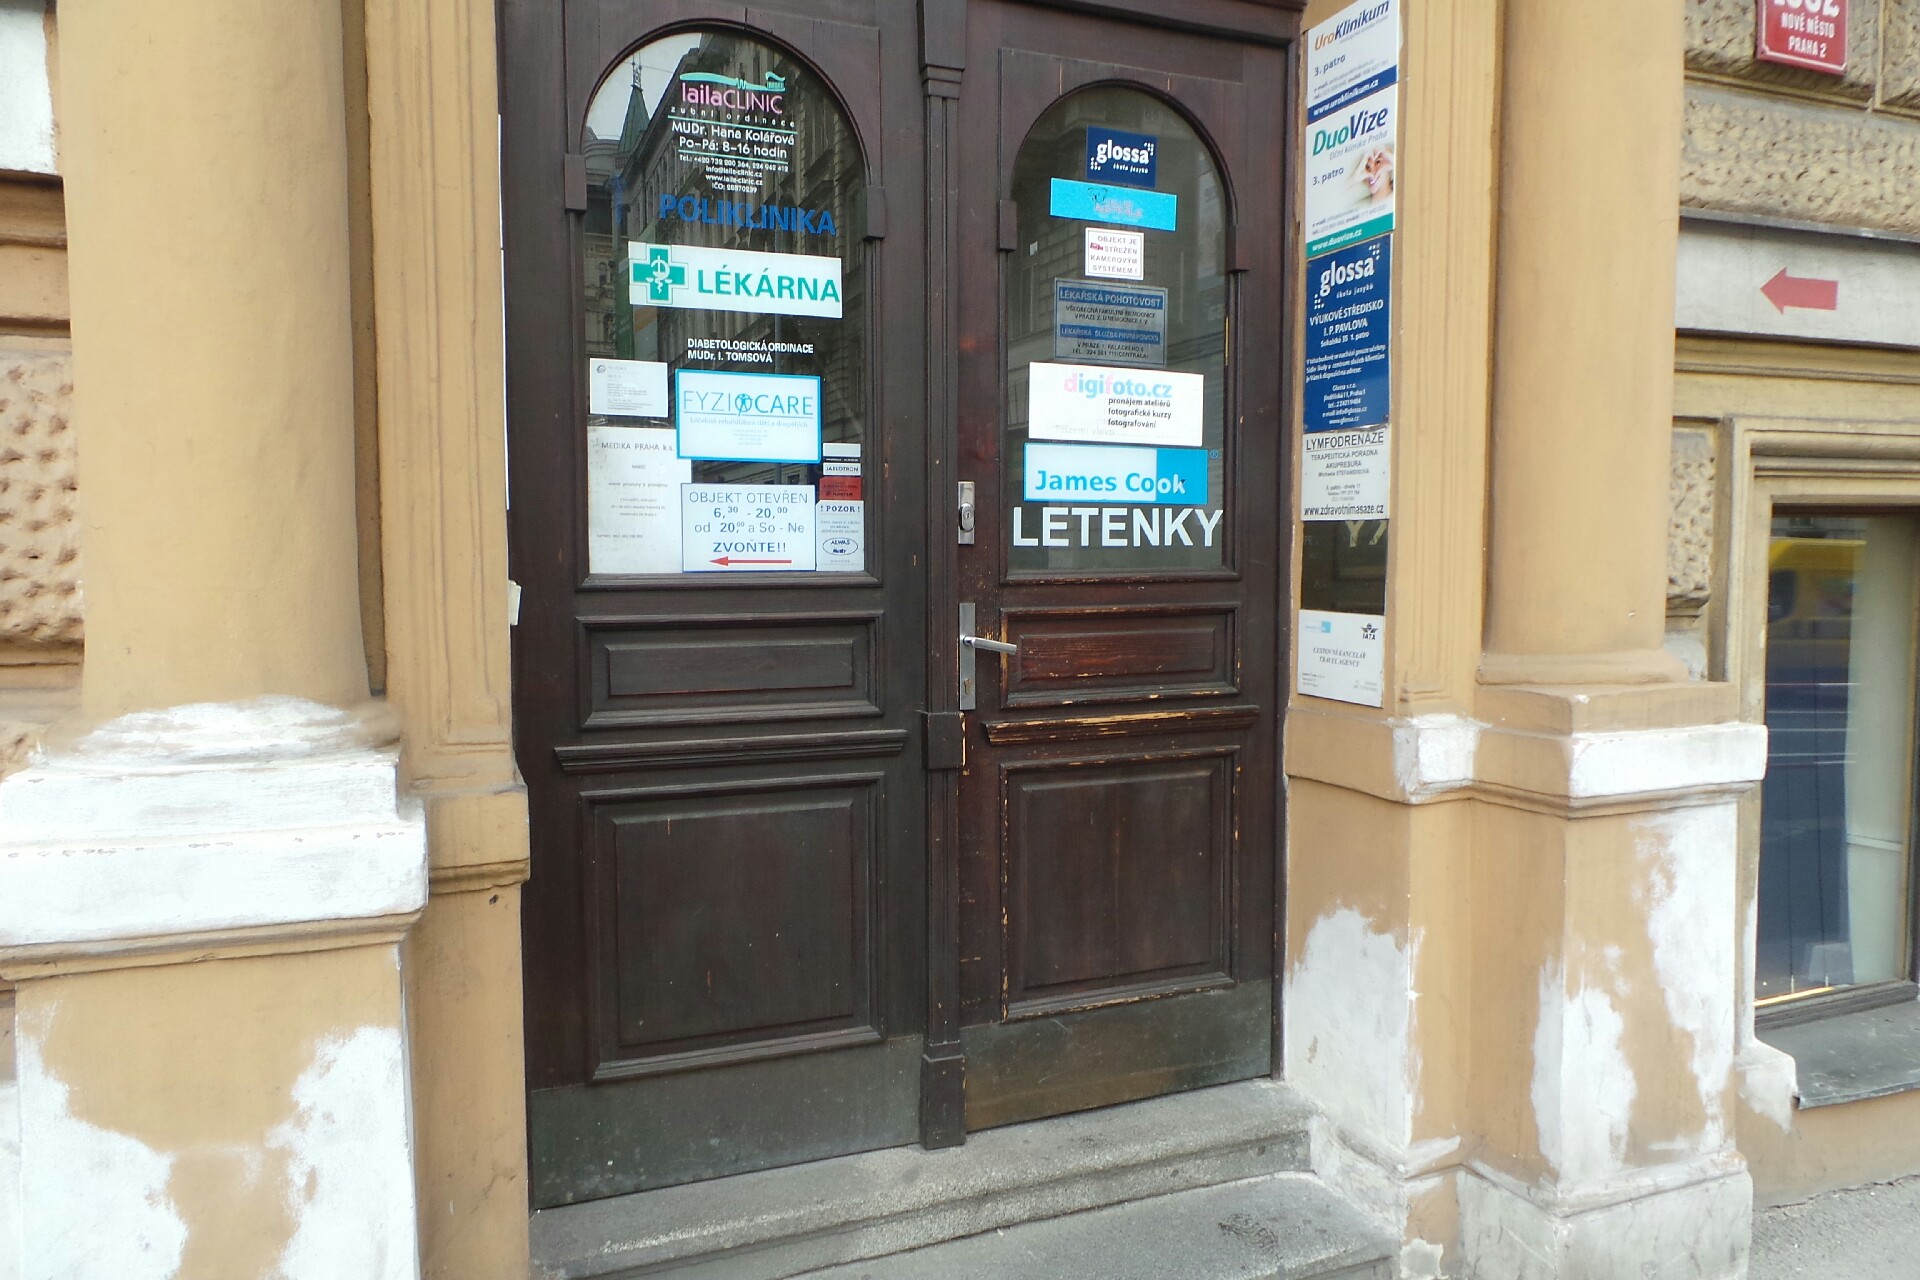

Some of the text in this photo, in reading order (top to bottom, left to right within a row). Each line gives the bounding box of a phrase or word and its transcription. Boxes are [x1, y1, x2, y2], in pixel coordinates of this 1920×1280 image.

[1314, 0, 1389, 50] UroKlinikum
[1781, 12, 1805, 32] NOVÉ
[1788, 36, 1827, 58] PRAHA 2
[1314, 67, 1321, 76] 3.
[1323, 54, 1346, 74] patro
[682, 82, 783, 114] lailaCLINIC
[672, 121, 794, 146] MUDr. Hana Kolářová
[1312, 107, 1388, 158] DuoVize
[754, 144, 787, 158] hodin
[1096, 139, 1150, 164] glossa
[1312, 167, 1344, 186] 3. patro
[658, 194, 836, 236] POLIKLINIKA
[1098, 236, 1126, 244] OBJEKT
[697, 264, 840, 302] LÉKÁRNA
[1320, 257, 1375, 297] glossa
[1060, 288, 1161, 308] LÉKAŘSKÁ POHOTOVOST
[1310, 299, 1384, 326] VÝUKOVÉ STŘEDISKO
[688, 338, 814, 354] DIABETOLOGICKÁ ORDINACE
[688, 350, 716, 360] MUDr.
[725, 352, 773, 363] TOMSOVÁ
[1064, 373, 1172, 399] digifoto.cz
[1108, 397, 1143, 406] pronájem
[1108, 408, 1172, 420] fotografické kurzy
[1108, 418, 1156, 428] fotografování
[601, 442, 631, 450] MEDIKA
[634, 443, 660, 451] PRAHA
[1351, 450, 1378, 459] PORADNA
[1326, 460, 1362, 469] AKUPRESURA
[1035, 470, 1186, 494] James Cook
[689, 490, 808, 504] OBJEKT OTEVŘEN
[826, 505, 856, 513] POZOR
[694, 522, 711, 533] od
[748, 525, 755, 533] a
[759, 522, 776, 533] So
[788, 522, 804, 533] Ne
[1013, 506, 1224, 548] LETENKY
[712, 538, 786, 553] ZVOŇTE!!
